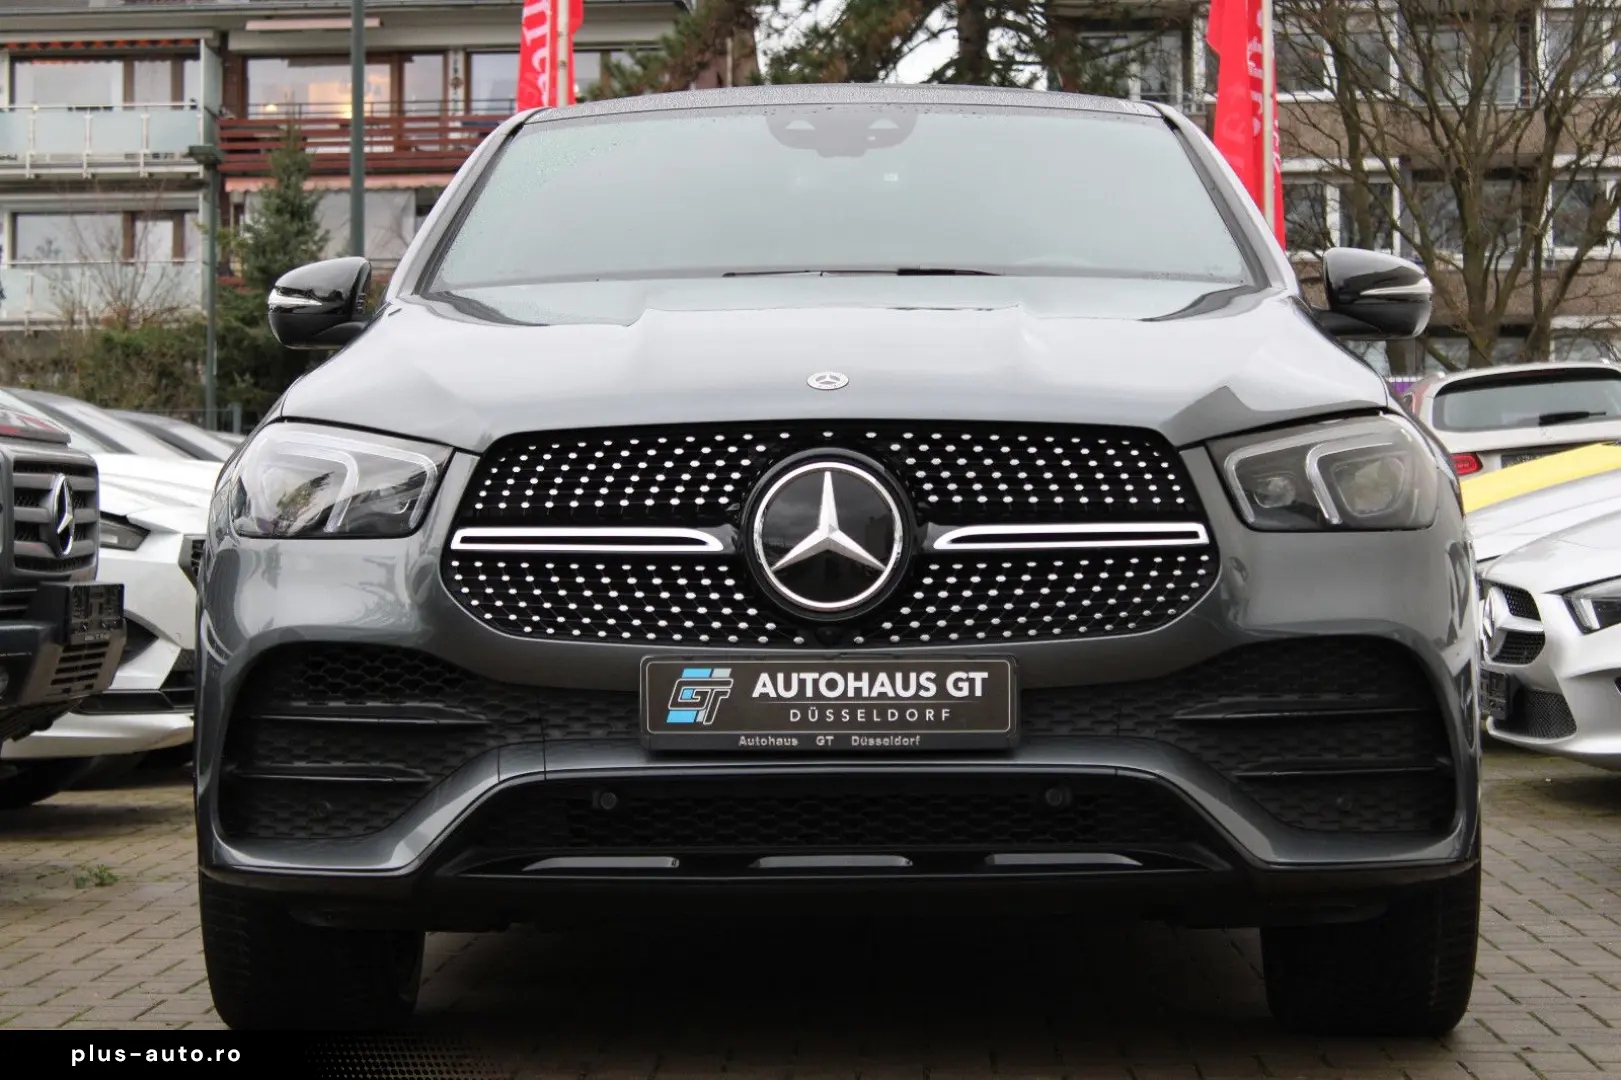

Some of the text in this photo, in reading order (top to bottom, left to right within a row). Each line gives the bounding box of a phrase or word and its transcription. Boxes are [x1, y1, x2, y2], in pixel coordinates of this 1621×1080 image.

[752, 671, 989, 698] AUTOHAUS GT
[668, 678, 734, 725] GT
[789, 706, 951, 722] DÜSSELDORF
[738, 735, 921, 747] Autohaus GT Düsseldorf
